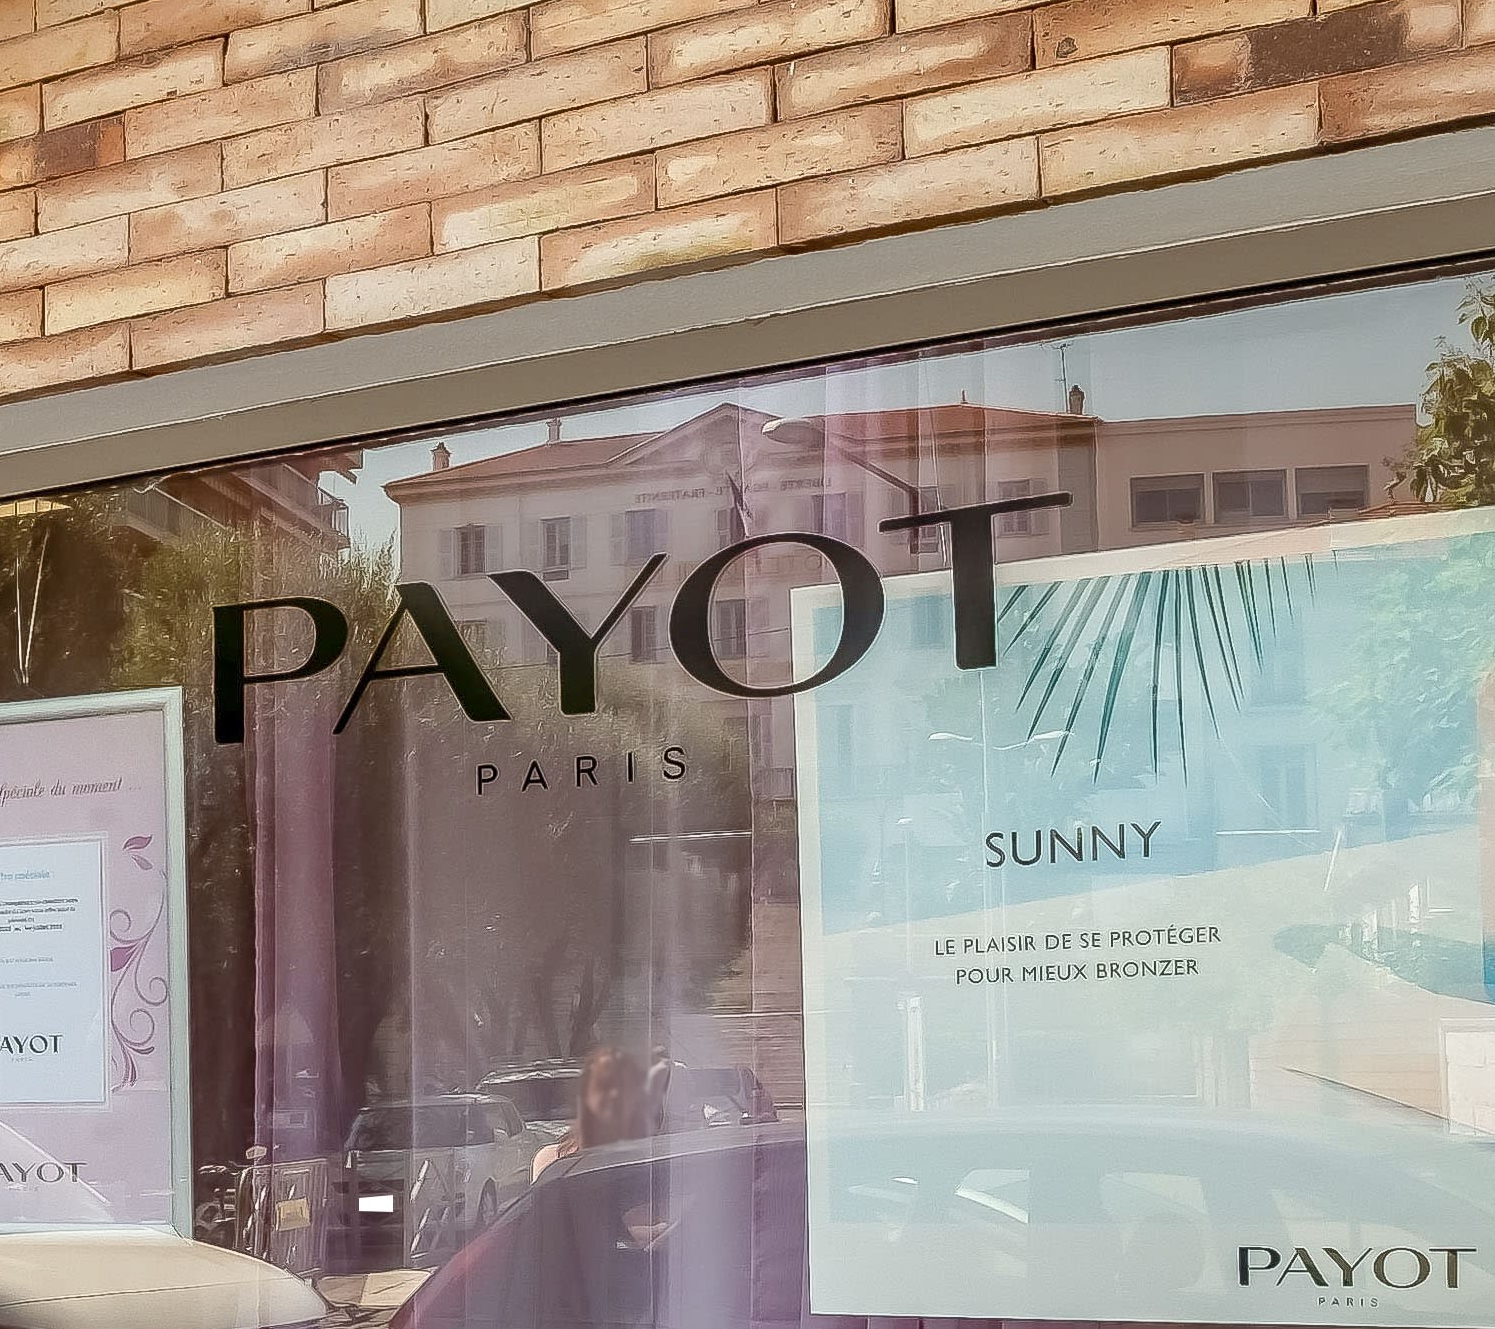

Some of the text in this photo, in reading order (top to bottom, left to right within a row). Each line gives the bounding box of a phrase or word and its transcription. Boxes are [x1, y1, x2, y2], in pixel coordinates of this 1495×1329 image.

[211, 491, 1075, 747] PAYOT
[51, 779, 66, 796] du
[72, 776, 123, 794] moment
[475, 746, 690, 795] PARIS
[985, 821, 1163, 869] SUNNY
[933, 922, 1223, 958] LE PLAISIR DE SE PROTÉGER
[955, 957, 1200, 985] POUR MIEUX BRONZER
[1237, 1244, 1477, 1290] PAYOT
[1317, 1294, 1381, 1308] PARIS
